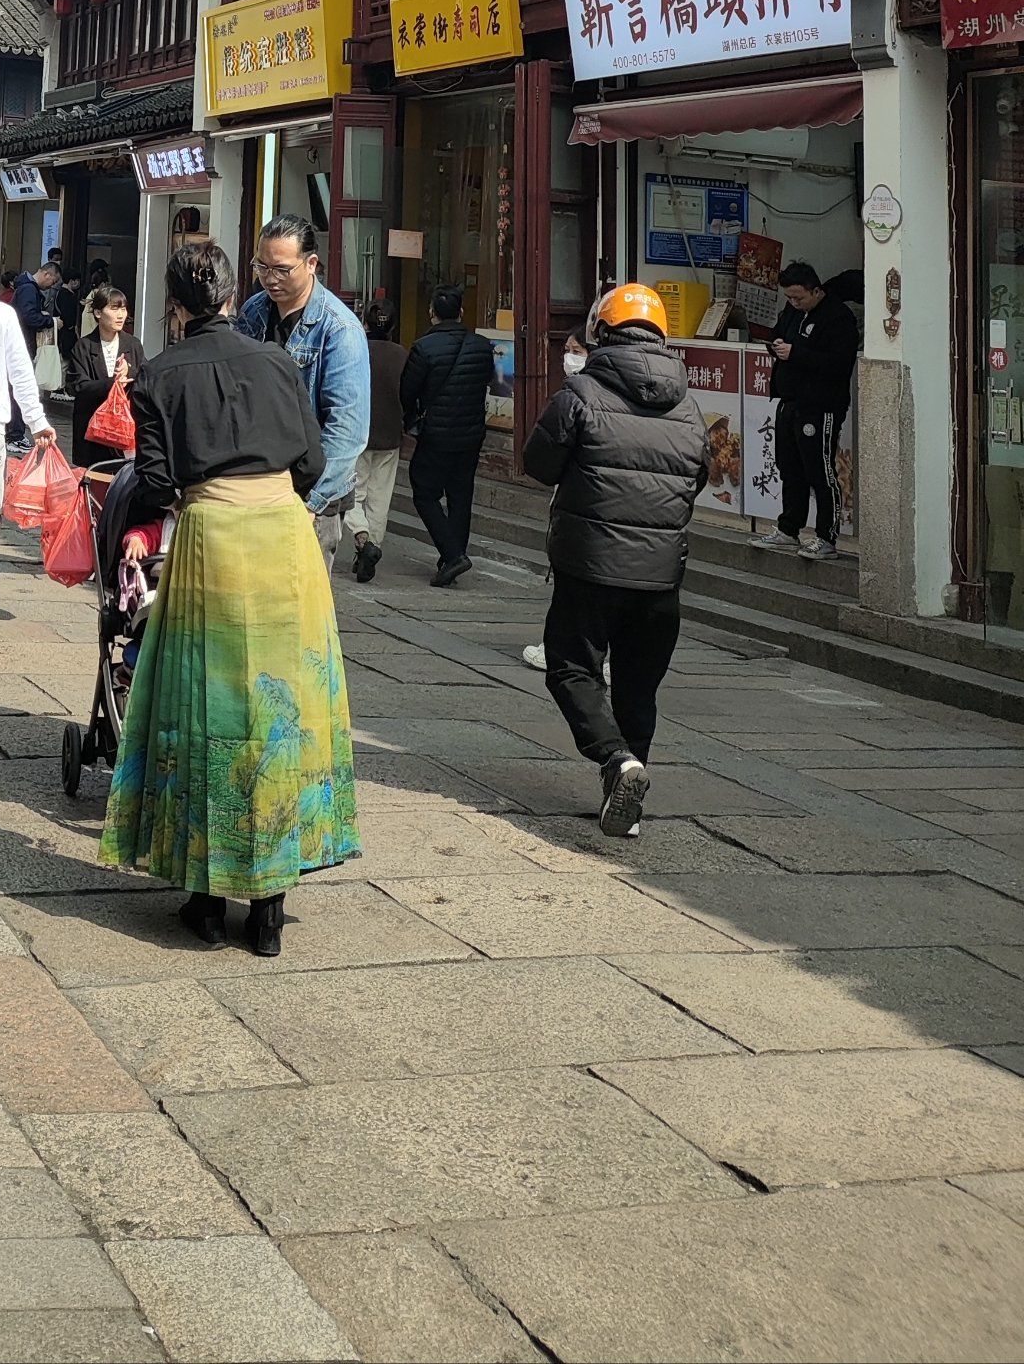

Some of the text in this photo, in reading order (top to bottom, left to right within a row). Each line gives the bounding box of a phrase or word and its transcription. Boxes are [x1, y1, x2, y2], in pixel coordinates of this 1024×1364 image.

[722, 27, 820, 53] 湖州总店 衣裳街105号
[612, 48, 676, 70] 400-801-5579
[992, 352, 1005, 367] 推
